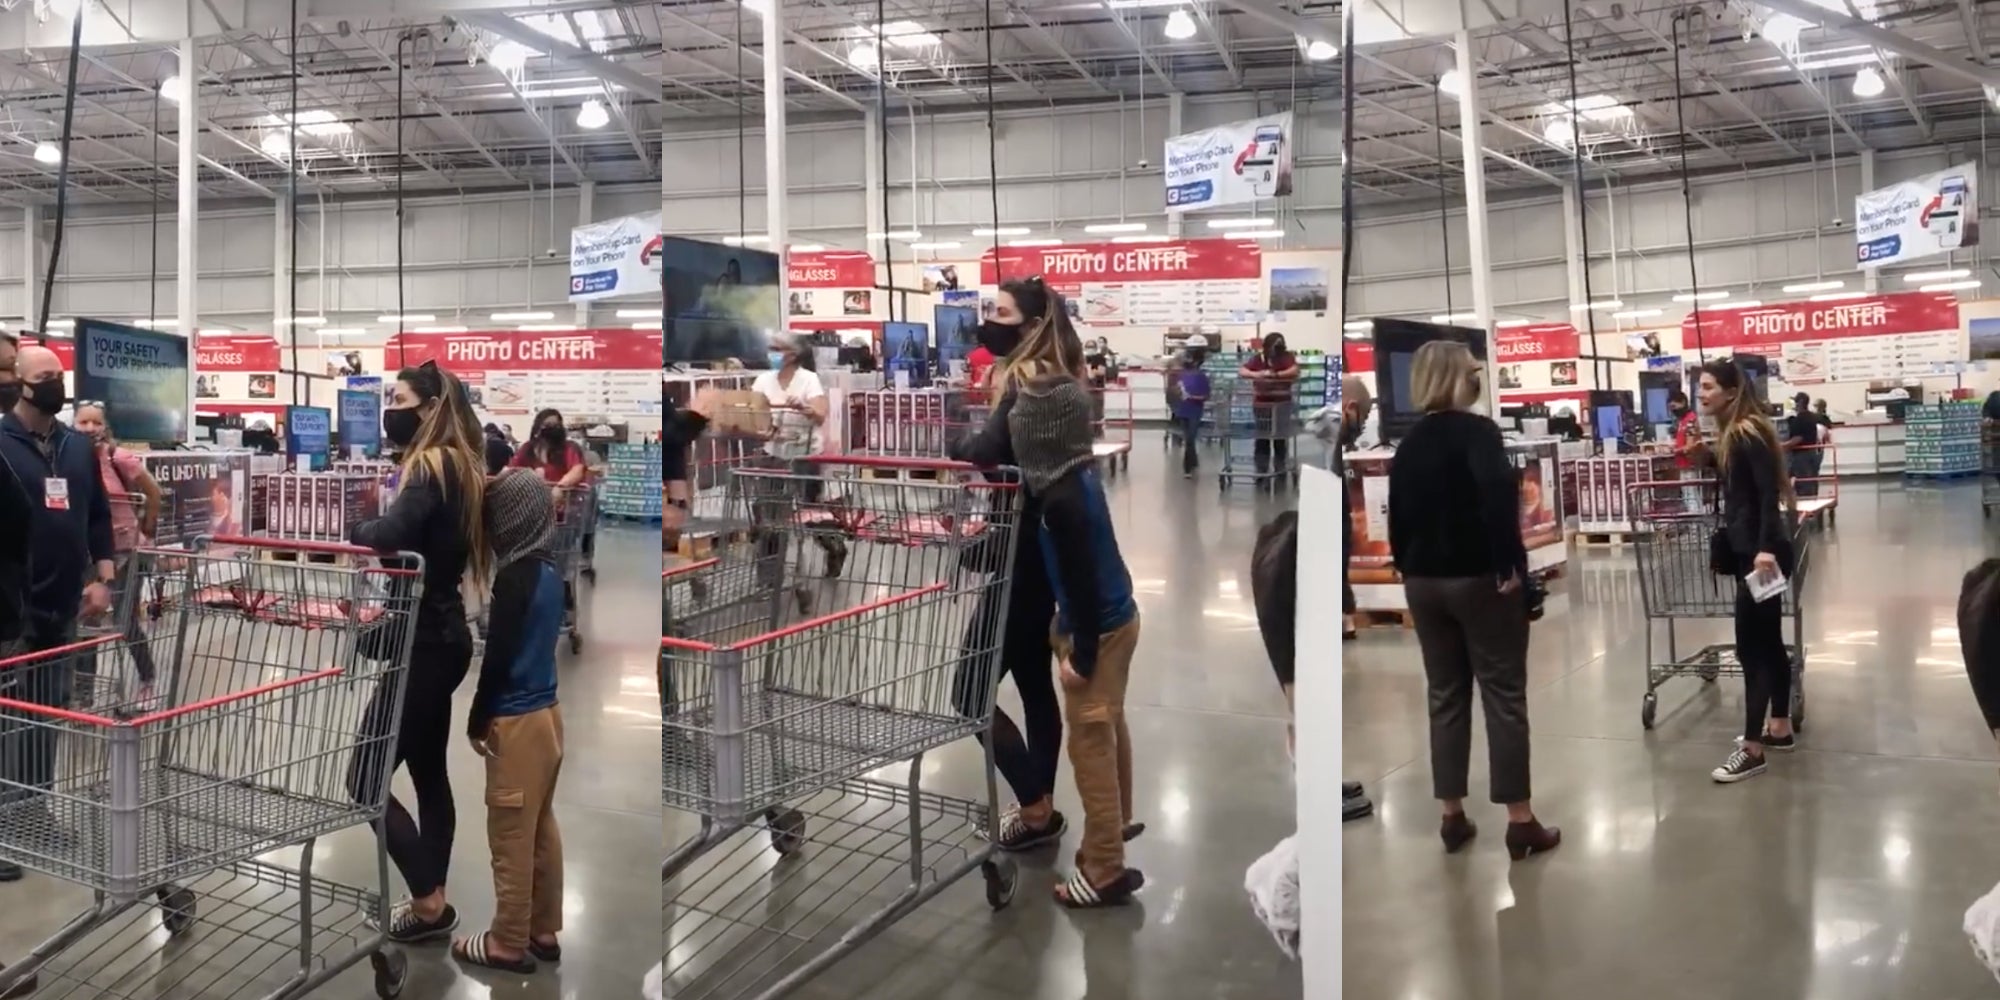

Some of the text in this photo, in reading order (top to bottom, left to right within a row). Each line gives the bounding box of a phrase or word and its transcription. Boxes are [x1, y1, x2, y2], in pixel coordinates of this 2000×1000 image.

[1214, 144, 1234, 156] Card
[1167, 161, 1219, 179] on Your Phone
[1902, 198, 1920, 210] Card
[1859, 227, 1870, 235] on
[1870, 222, 1885, 232] Your
[622, 233, 642, 246] Card
[573, 259, 585, 267] on
[585, 255, 601, 266] Your
[1043, 250, 1188, 274] PHOTO CENTER
[1743, 306, 1887, 335] PHOTO CENTER
[93, 336, 160, 359] YOUR SAFETY
[447, 340, 596, 361] PHOTO CENTER
[95, 353, 105, 368] IS
[107, 354, 128, 370] OUR
[155, 465, 170, 482] LG
[172, 464, 193, 481] UHD
[194, 463, 208, 480] TV
